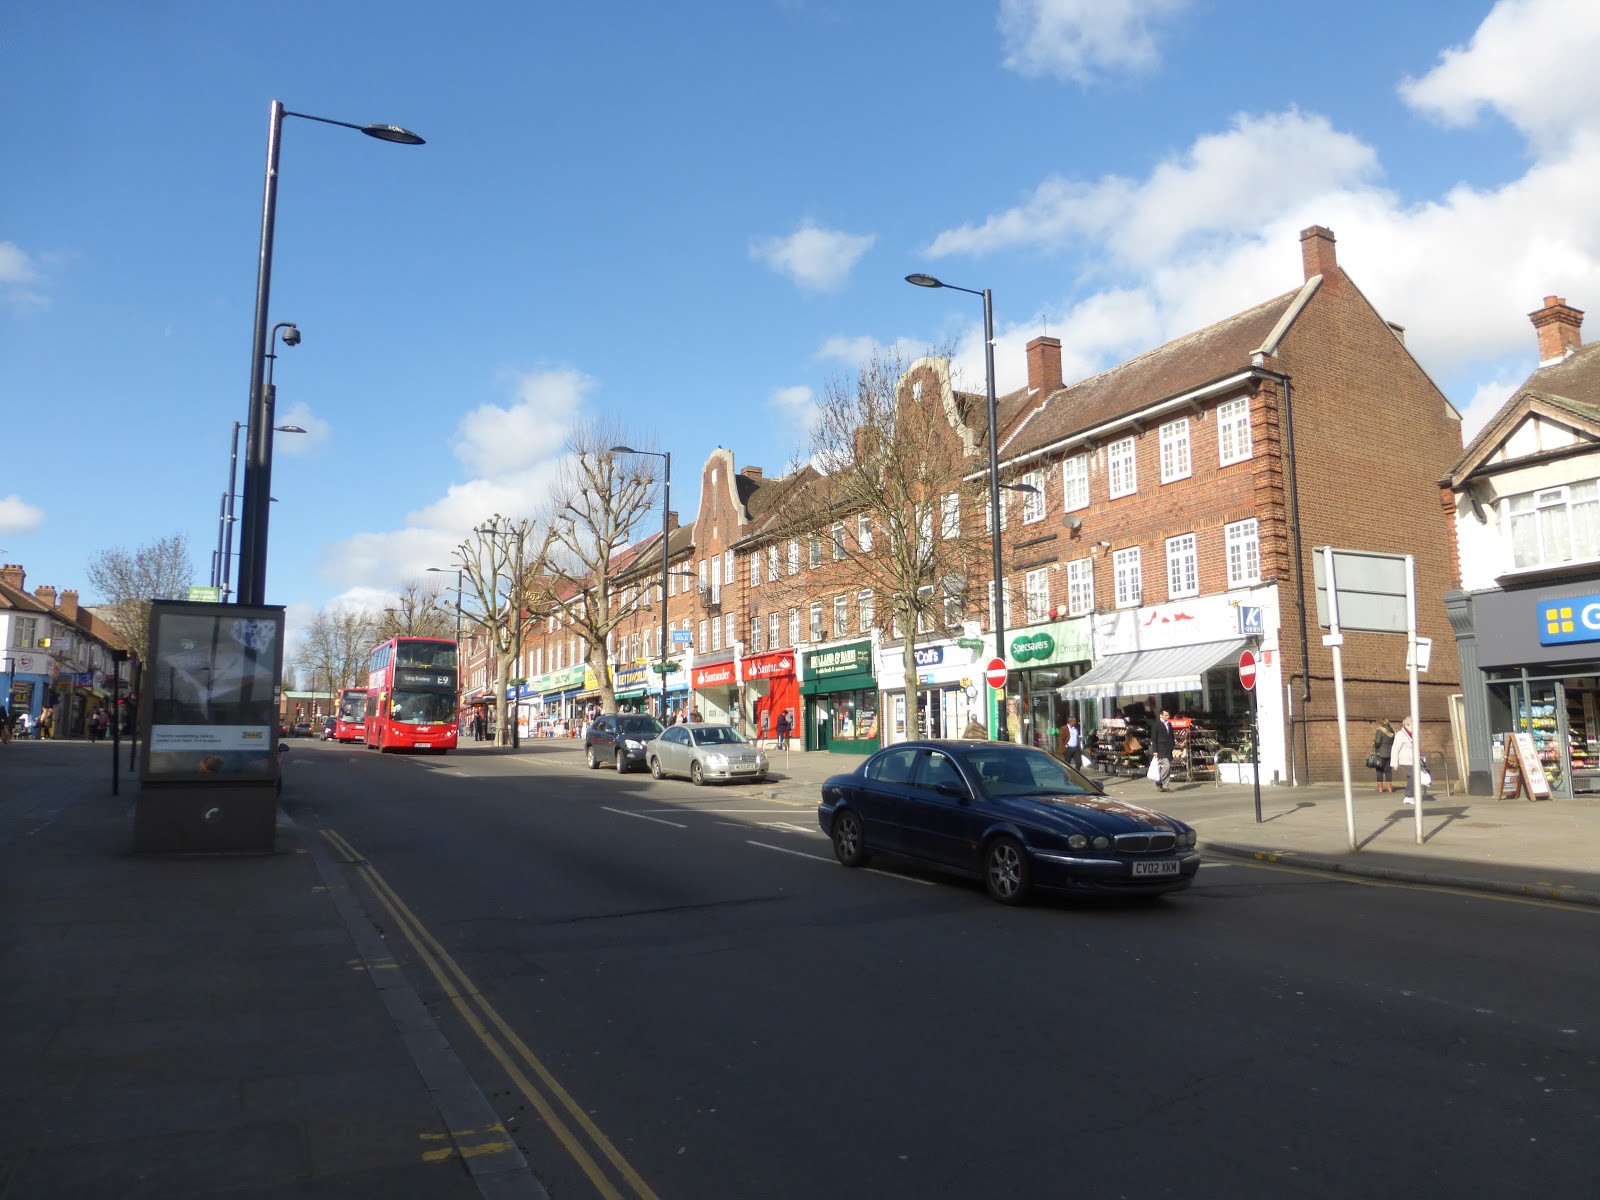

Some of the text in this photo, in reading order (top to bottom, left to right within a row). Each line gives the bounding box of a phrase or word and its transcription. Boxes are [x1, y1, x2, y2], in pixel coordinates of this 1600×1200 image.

[1245, 607, 1260, 627] K
[1243, 626, 1261, 634] SHOES
[1013, 640, 1049, 655] Specsavers
[1059, 642, 1089, 655] Opticians
[437, 675, 449, 684] E9
[704, 668, 730, 683] Santander
[1136, 861, 1177, 874] CV02 XKM
